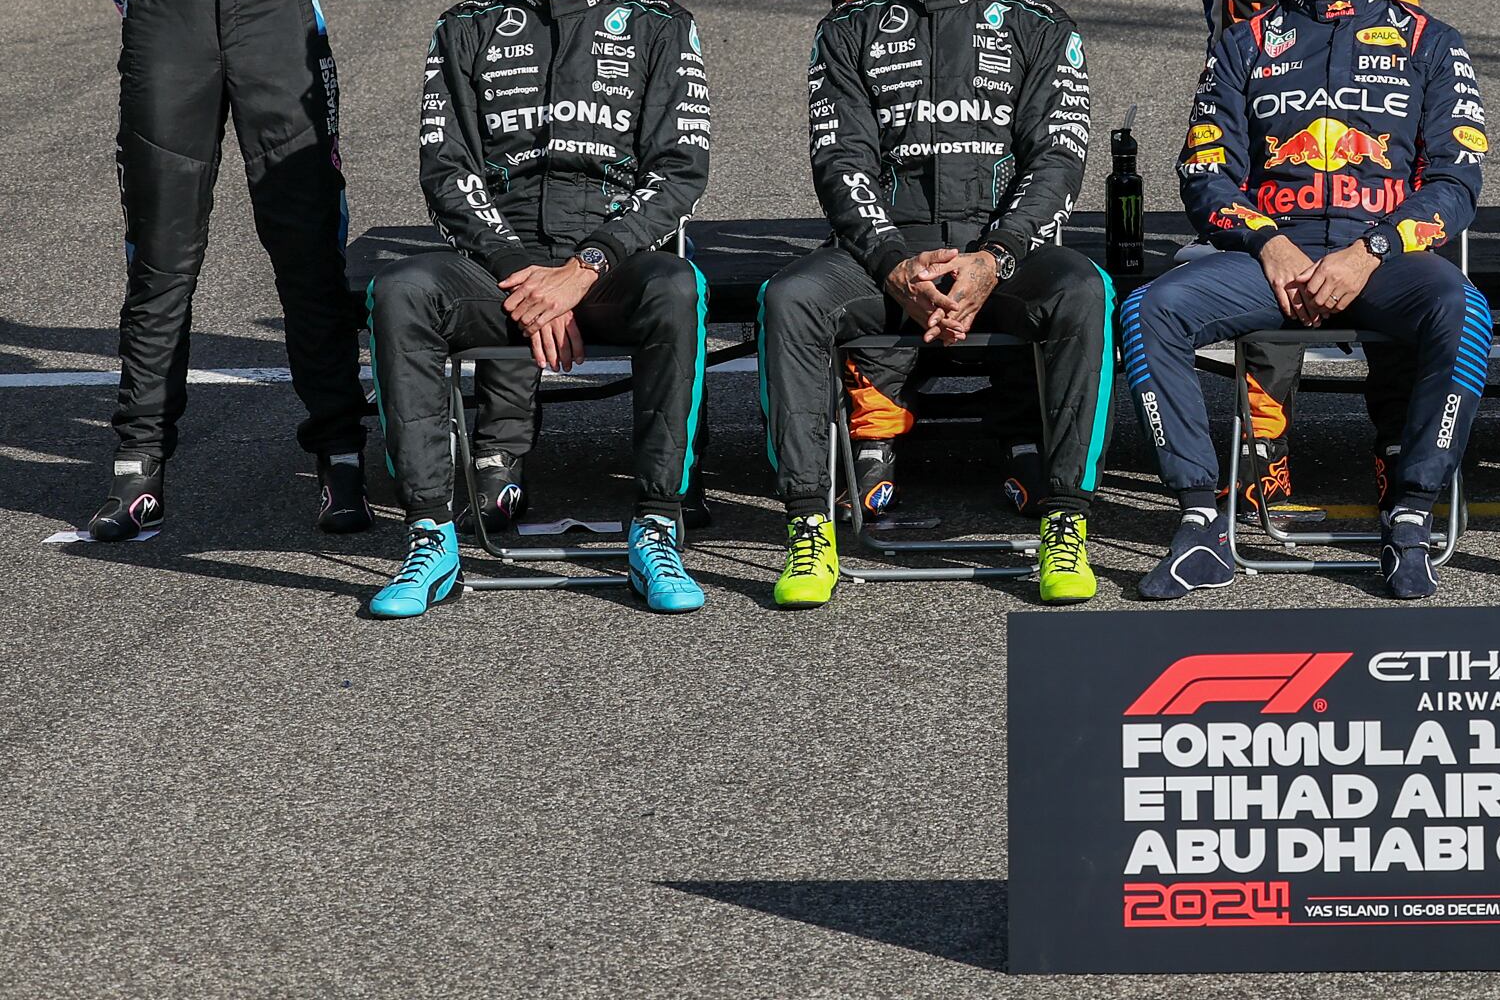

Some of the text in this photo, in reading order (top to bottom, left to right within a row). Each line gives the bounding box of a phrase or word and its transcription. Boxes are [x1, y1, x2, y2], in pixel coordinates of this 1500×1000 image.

[595, 31, 631, 41] PETRONAS
[1267, 30, 1295, 45] TAG
[504, 44, 534, 58] UBS
[591, 42, 635, 59] INEOS
[887, 38, 916, 54] UBS
[1265, 40, 1296, 56] HEUER
[870, 60, 923, 76] CROWDSTRIKE
[1250, 62, 1289, 80] Mobil
[1358, 54, 1407, 72] BYBIT
[485, 66, 539, 79] CROWDSTRIKE
[1354, 75, 1410, 86] HONDA
[496, 85, 538, 97] Snapdragon
[881, 79, 923, 93] Snapdragon
[1061, 93, 1089, 110] IWC
[1252, 87, 1410, 119] ORACLE
[485, 100, 632, 135] PETRONAS
[878, 100, 1012, 129] PETRONAS
[677, 135, 709, 151] AMD
[1463, 131, 1486, 148] RAUCH
[513, 138, 617, 163] CROWDSTRIKE
[893, 141, 1005, 159] CROWDSTRIKE
[1257, 173, 1405, 214] Red Bull
[1141, 390, 1167, 447] sparco
[1436, 393, 1461, 449] sparco
[1122, 720, 1458, 768] FORMULA
[1123, 774, 1379, 822] ETIHAD
[1123, 828, 1266, 875] ABU
[1277, 826, 1485, 873] DHABI
[1123, 882, 1290, 927] 2024
[1304, 905, 1333, 917] YAS
[1335, 904, 1390, 917] ISLAND
[1402, 903, 1445, 917] 06-08
